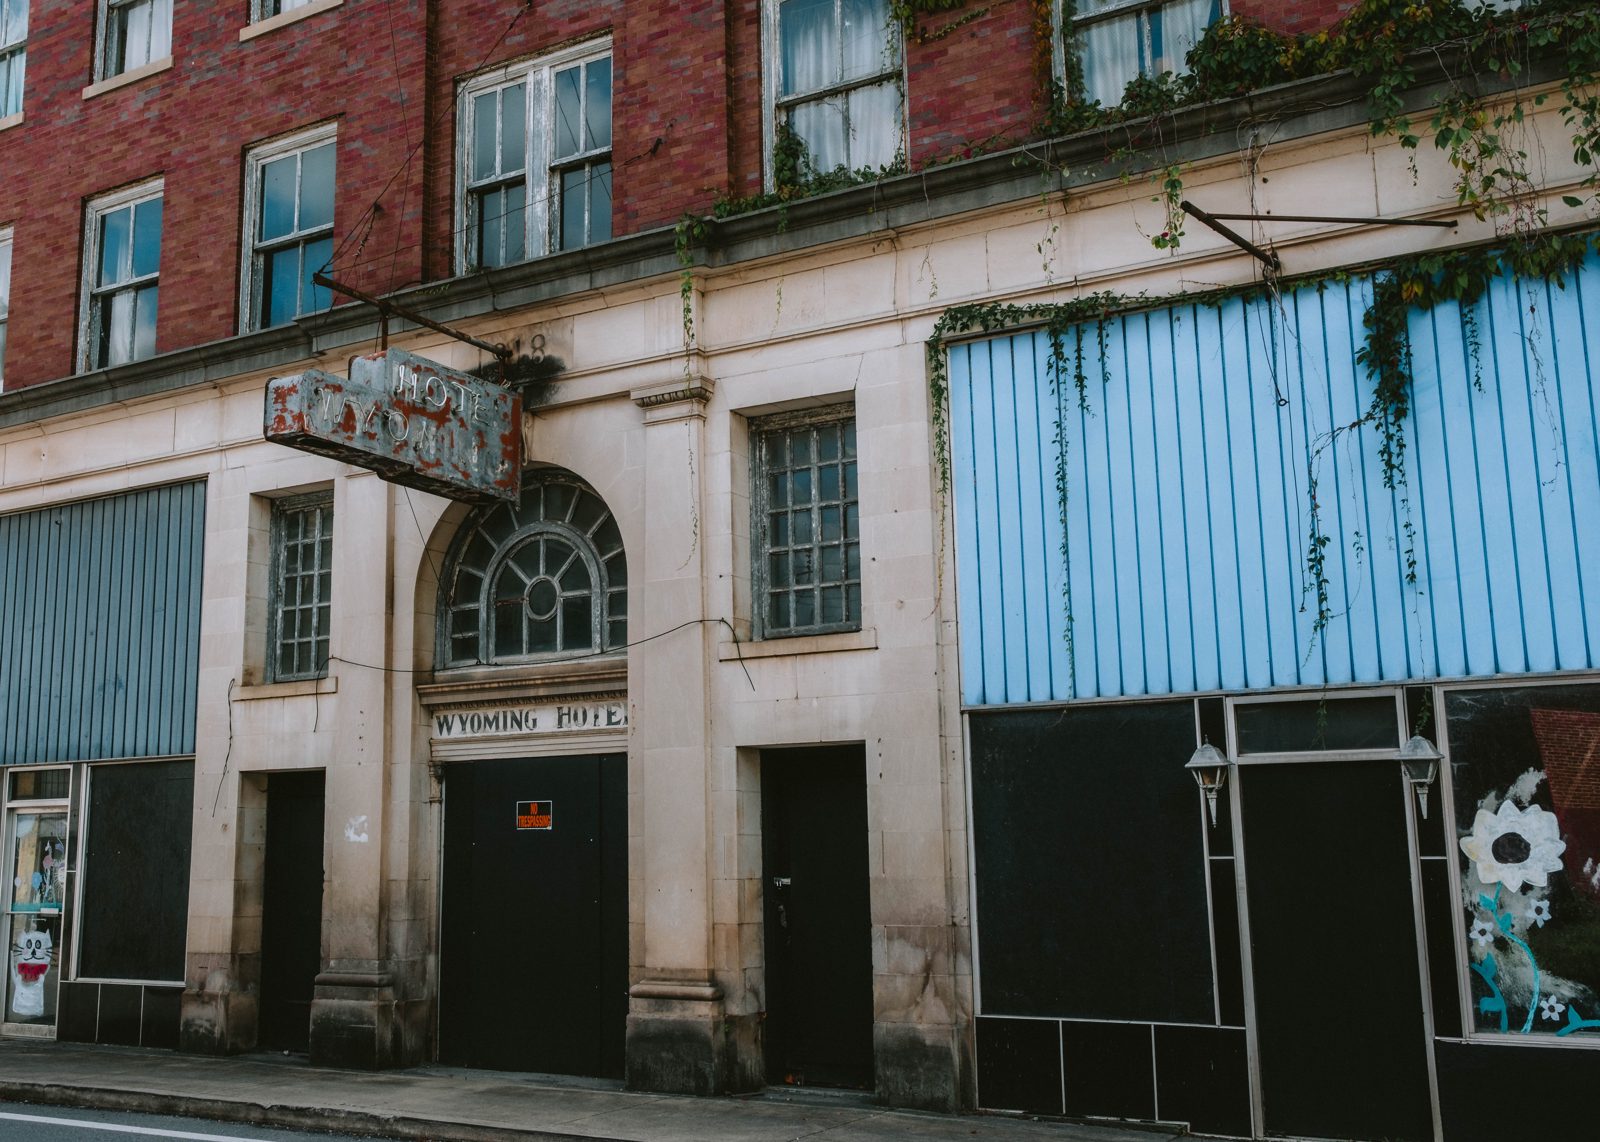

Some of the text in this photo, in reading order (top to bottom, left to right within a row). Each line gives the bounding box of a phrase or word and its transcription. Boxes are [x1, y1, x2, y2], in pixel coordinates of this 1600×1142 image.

[435, 708, 538, 737] WYOMING
[530, 802, 538, 815] NO
[518, 815, 551, 828] TRESPASSING
